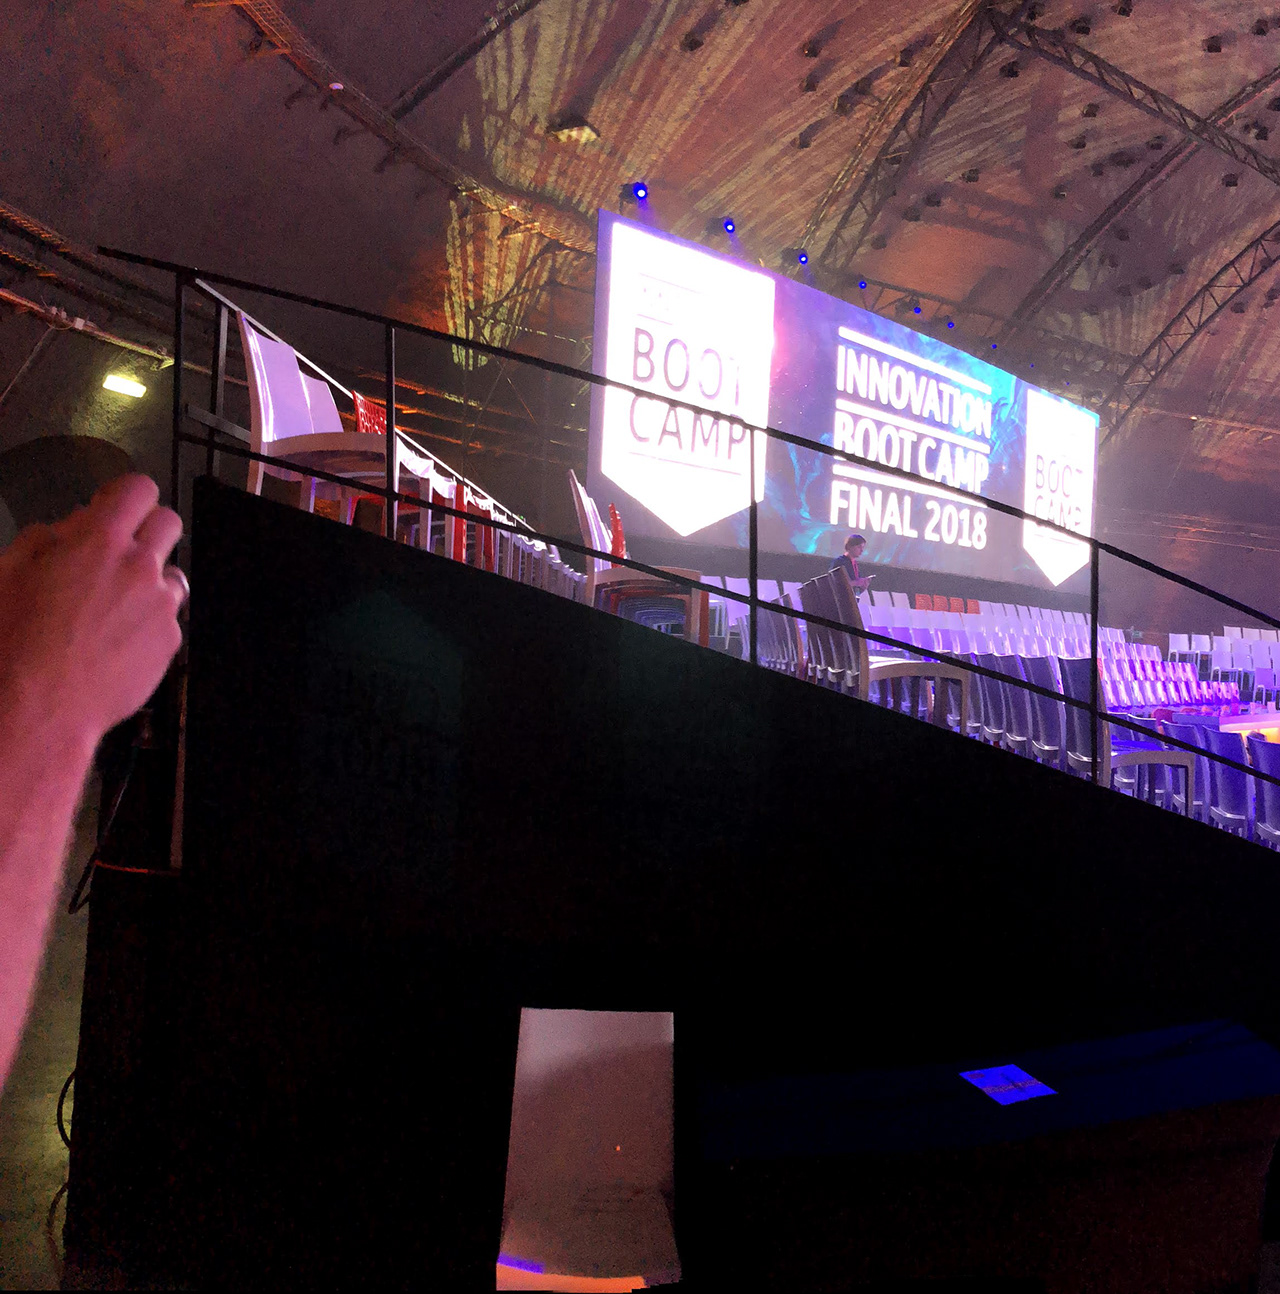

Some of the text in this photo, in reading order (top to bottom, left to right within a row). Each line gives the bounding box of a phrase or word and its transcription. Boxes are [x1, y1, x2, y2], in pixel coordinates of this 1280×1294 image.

[633, 327, 742, 406] BOOT
[836, 345, 992, 439] INNOVATION
[629, 394, 746, 460] CAMP
[1035, 454, 1083, 498] BOO
[830, 479, 988, 550] FINAL 2018
